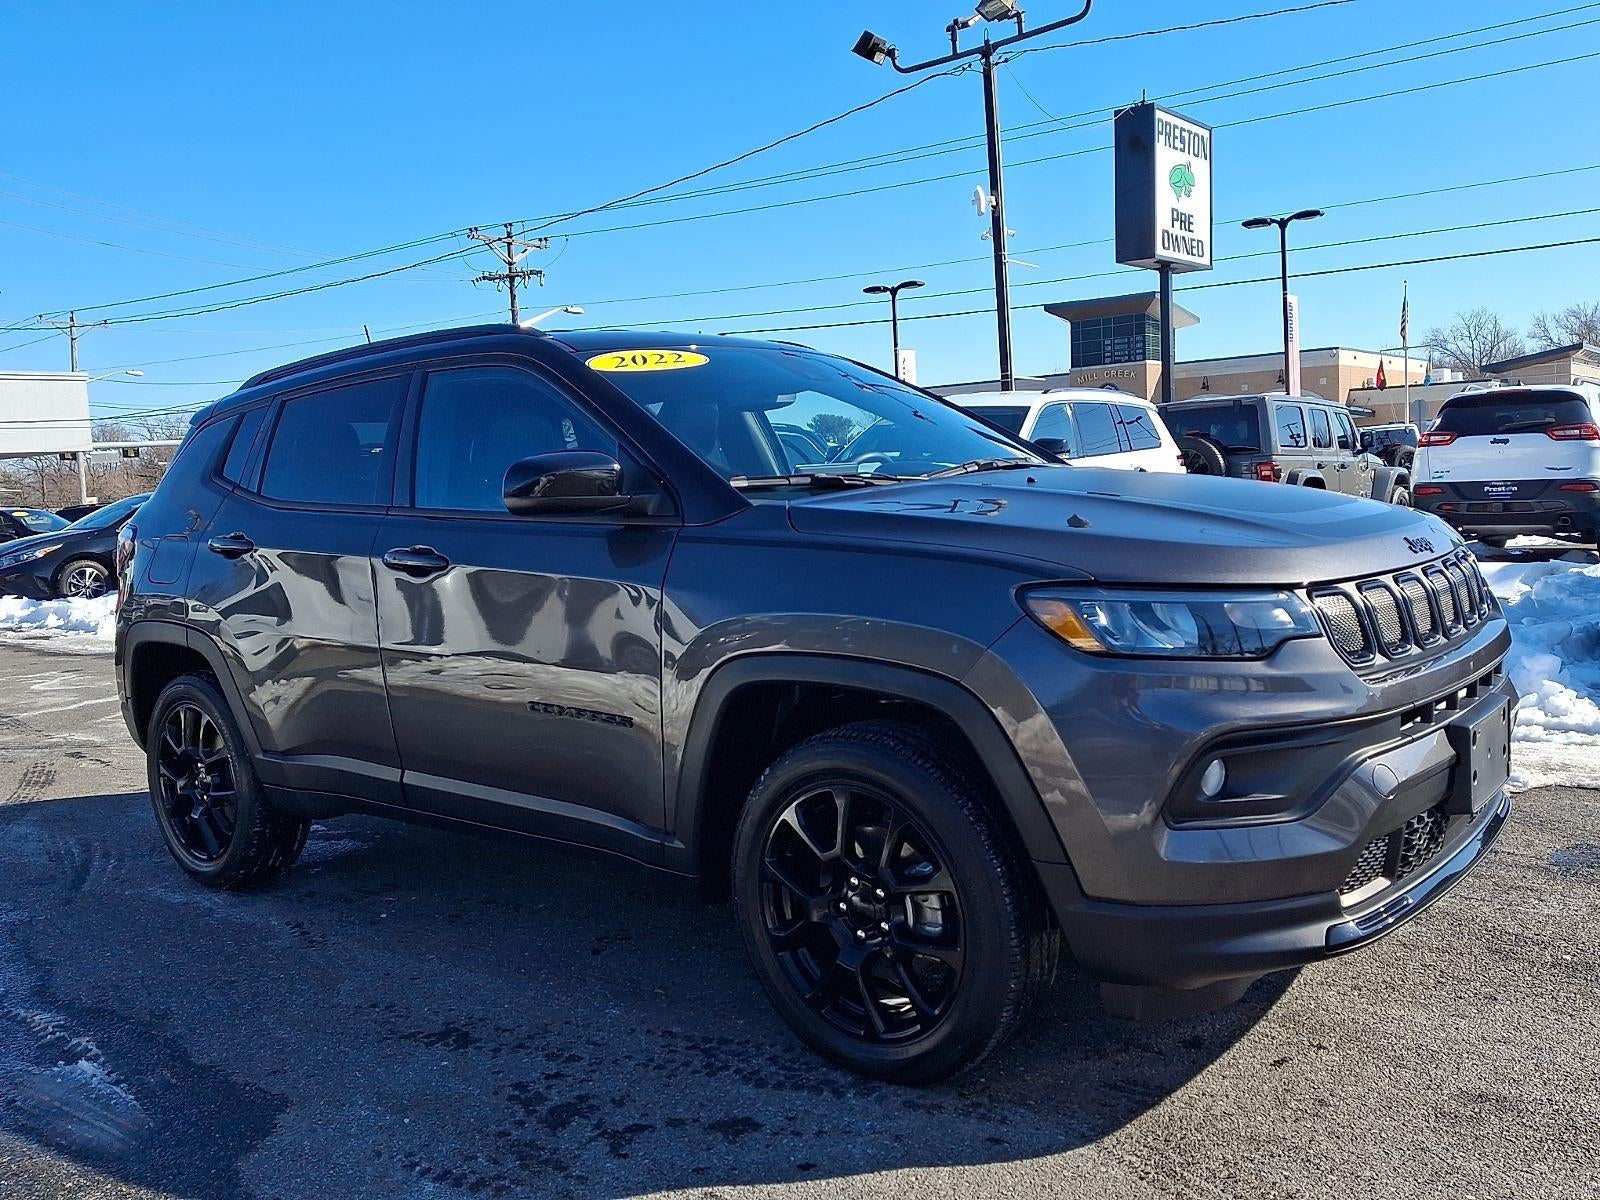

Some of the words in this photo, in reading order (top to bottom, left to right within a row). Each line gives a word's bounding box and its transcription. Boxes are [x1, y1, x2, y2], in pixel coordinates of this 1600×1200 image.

[1157, 117, 1208, 161] PRESTON
[1171, 207, 1195, 234] PRE
[1161, 229, 1205, 258] OWNED
[612, 352, 686, 369] 2022
[1077, 372, 1099, 385] MILL
[1104, 369, 1137, 379] CREEK
